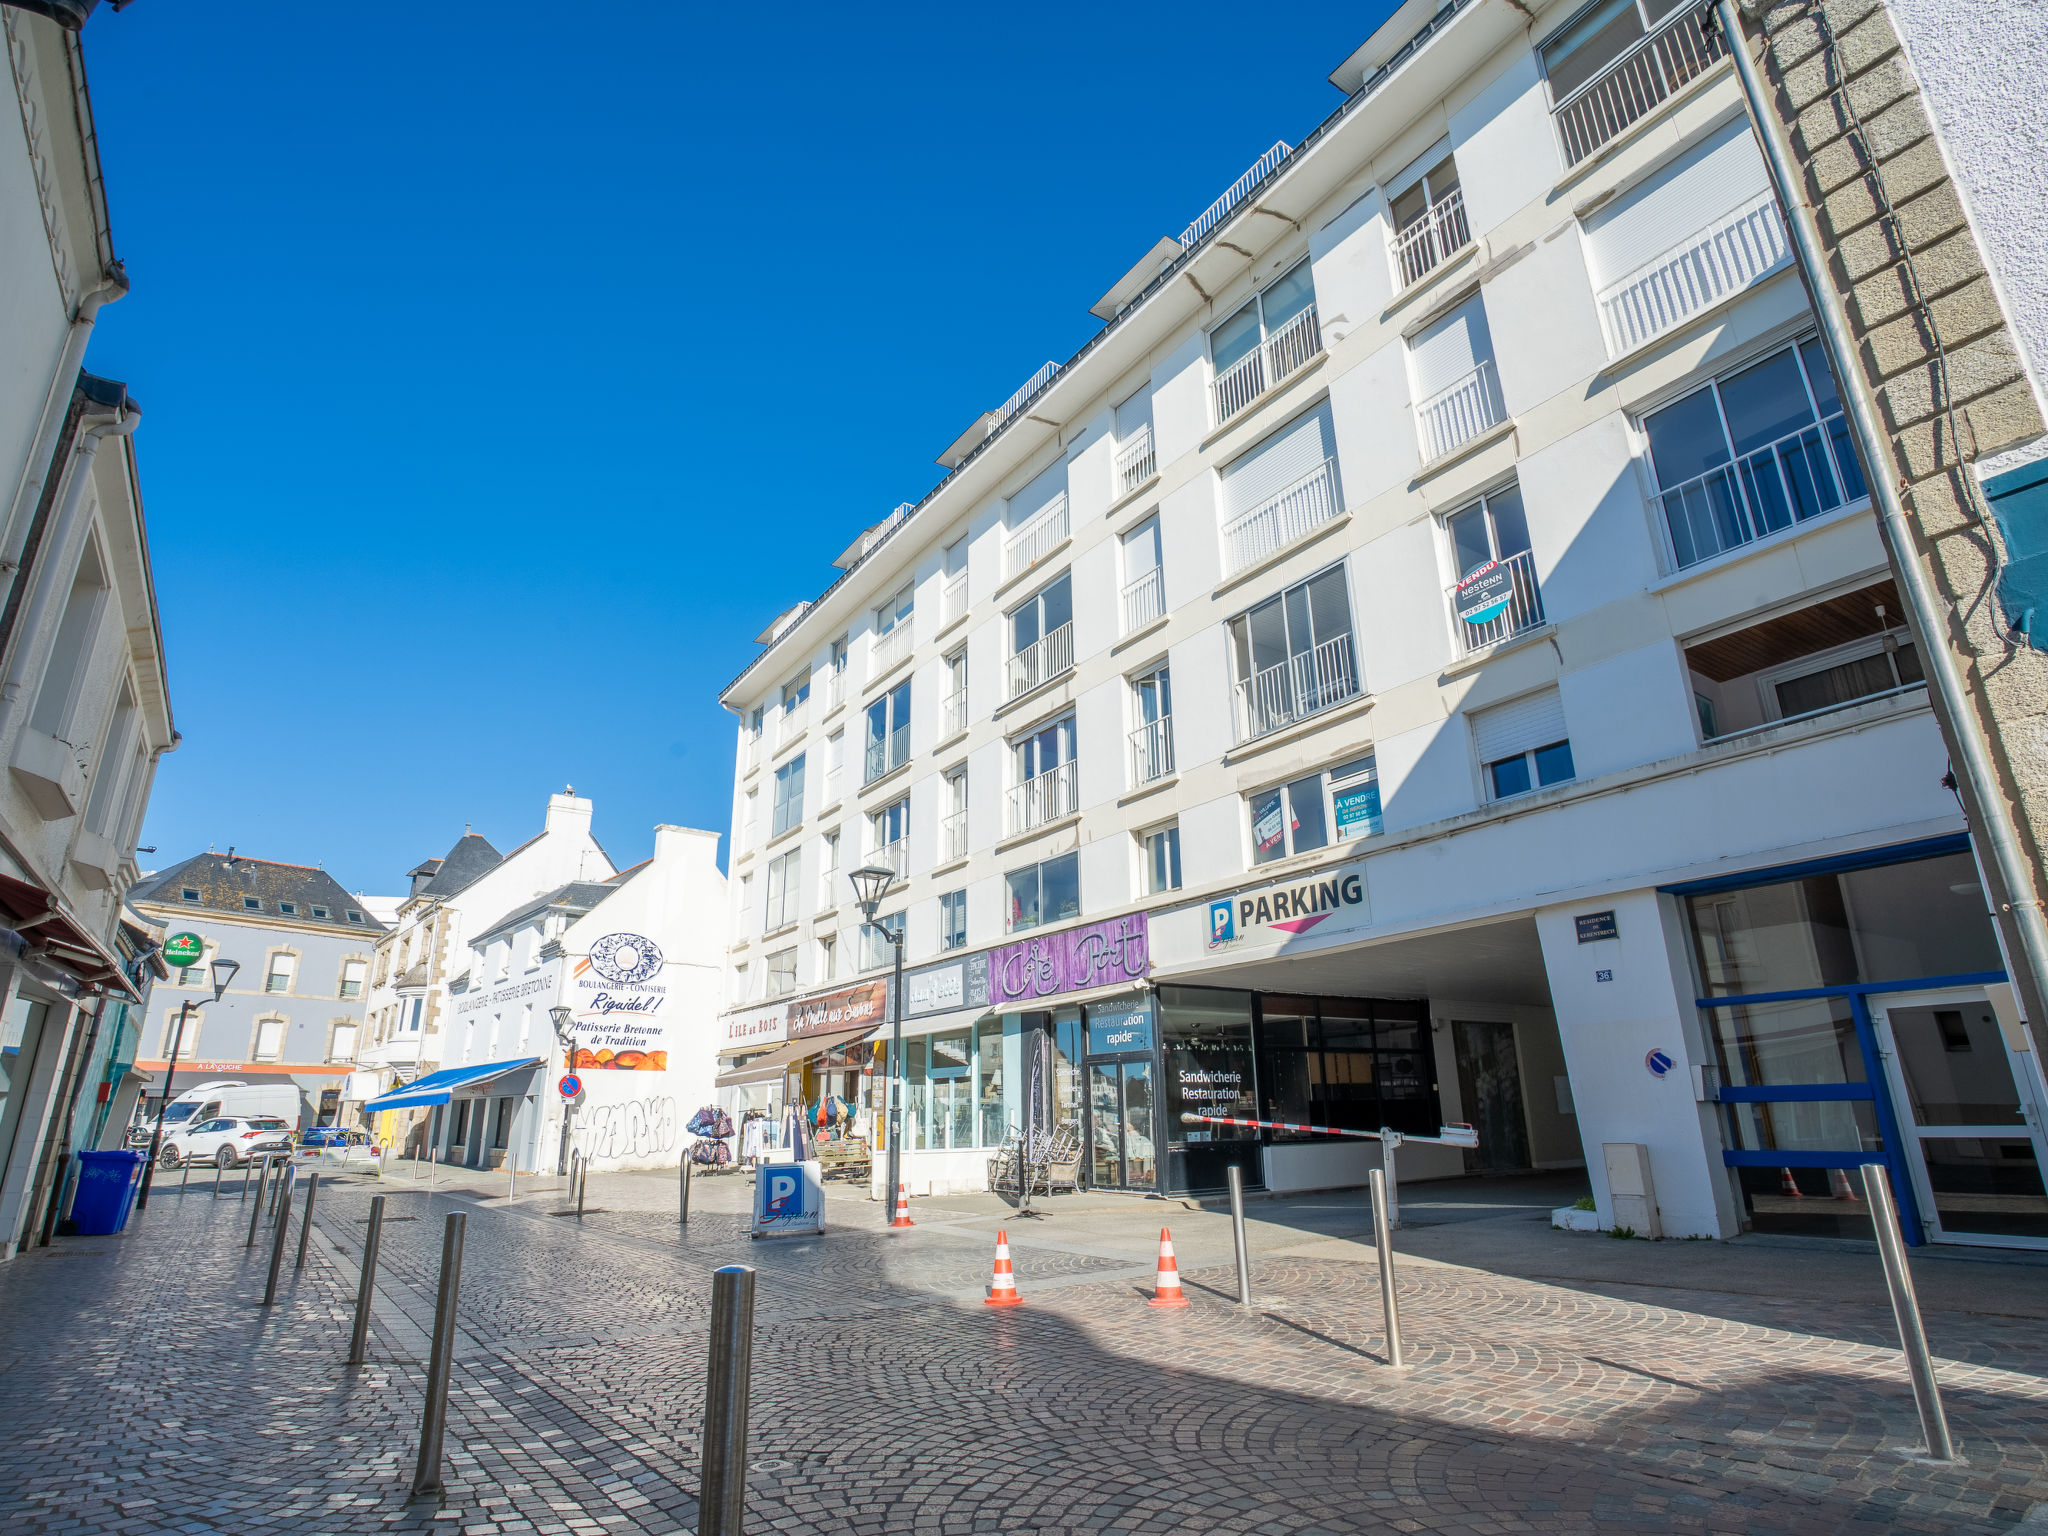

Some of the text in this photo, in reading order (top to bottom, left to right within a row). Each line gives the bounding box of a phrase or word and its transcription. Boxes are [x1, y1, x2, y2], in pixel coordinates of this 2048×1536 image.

[1459, 561, 1494, 588] VENDU
[1344, 791, 1376, 807] VENDRE
[1240, 874, 1363, 927] PARKING
[1214, 908, 1229, 936] P
[166, 949, 200, 957] Heineken
[1073, 919, 1146, 985] Port
[1599, 971, 1610, 980] 36
[578, 980, 666, 994] BOULANGERIE CONFISERIE
[1097, 1000, 1139, 1013] Sandwicherie
[575, 1021, 663, 1035] Patisserie Bretonne
[759, 1017, 778, 1033] BOIS
[1095, 1013, 1144, 1029] Restauration
[590, 1035, 647, 1047] de Tradition
[1107, 1030, 1133, 1046] rapide
[1179, 1069, 1242, 1083] Sandwicherie
[1182, 1087, 1240, 1100] Restauration
[1197, 1103, 1228, 1117] rapide
[771, 1175, 796, 1208] P
